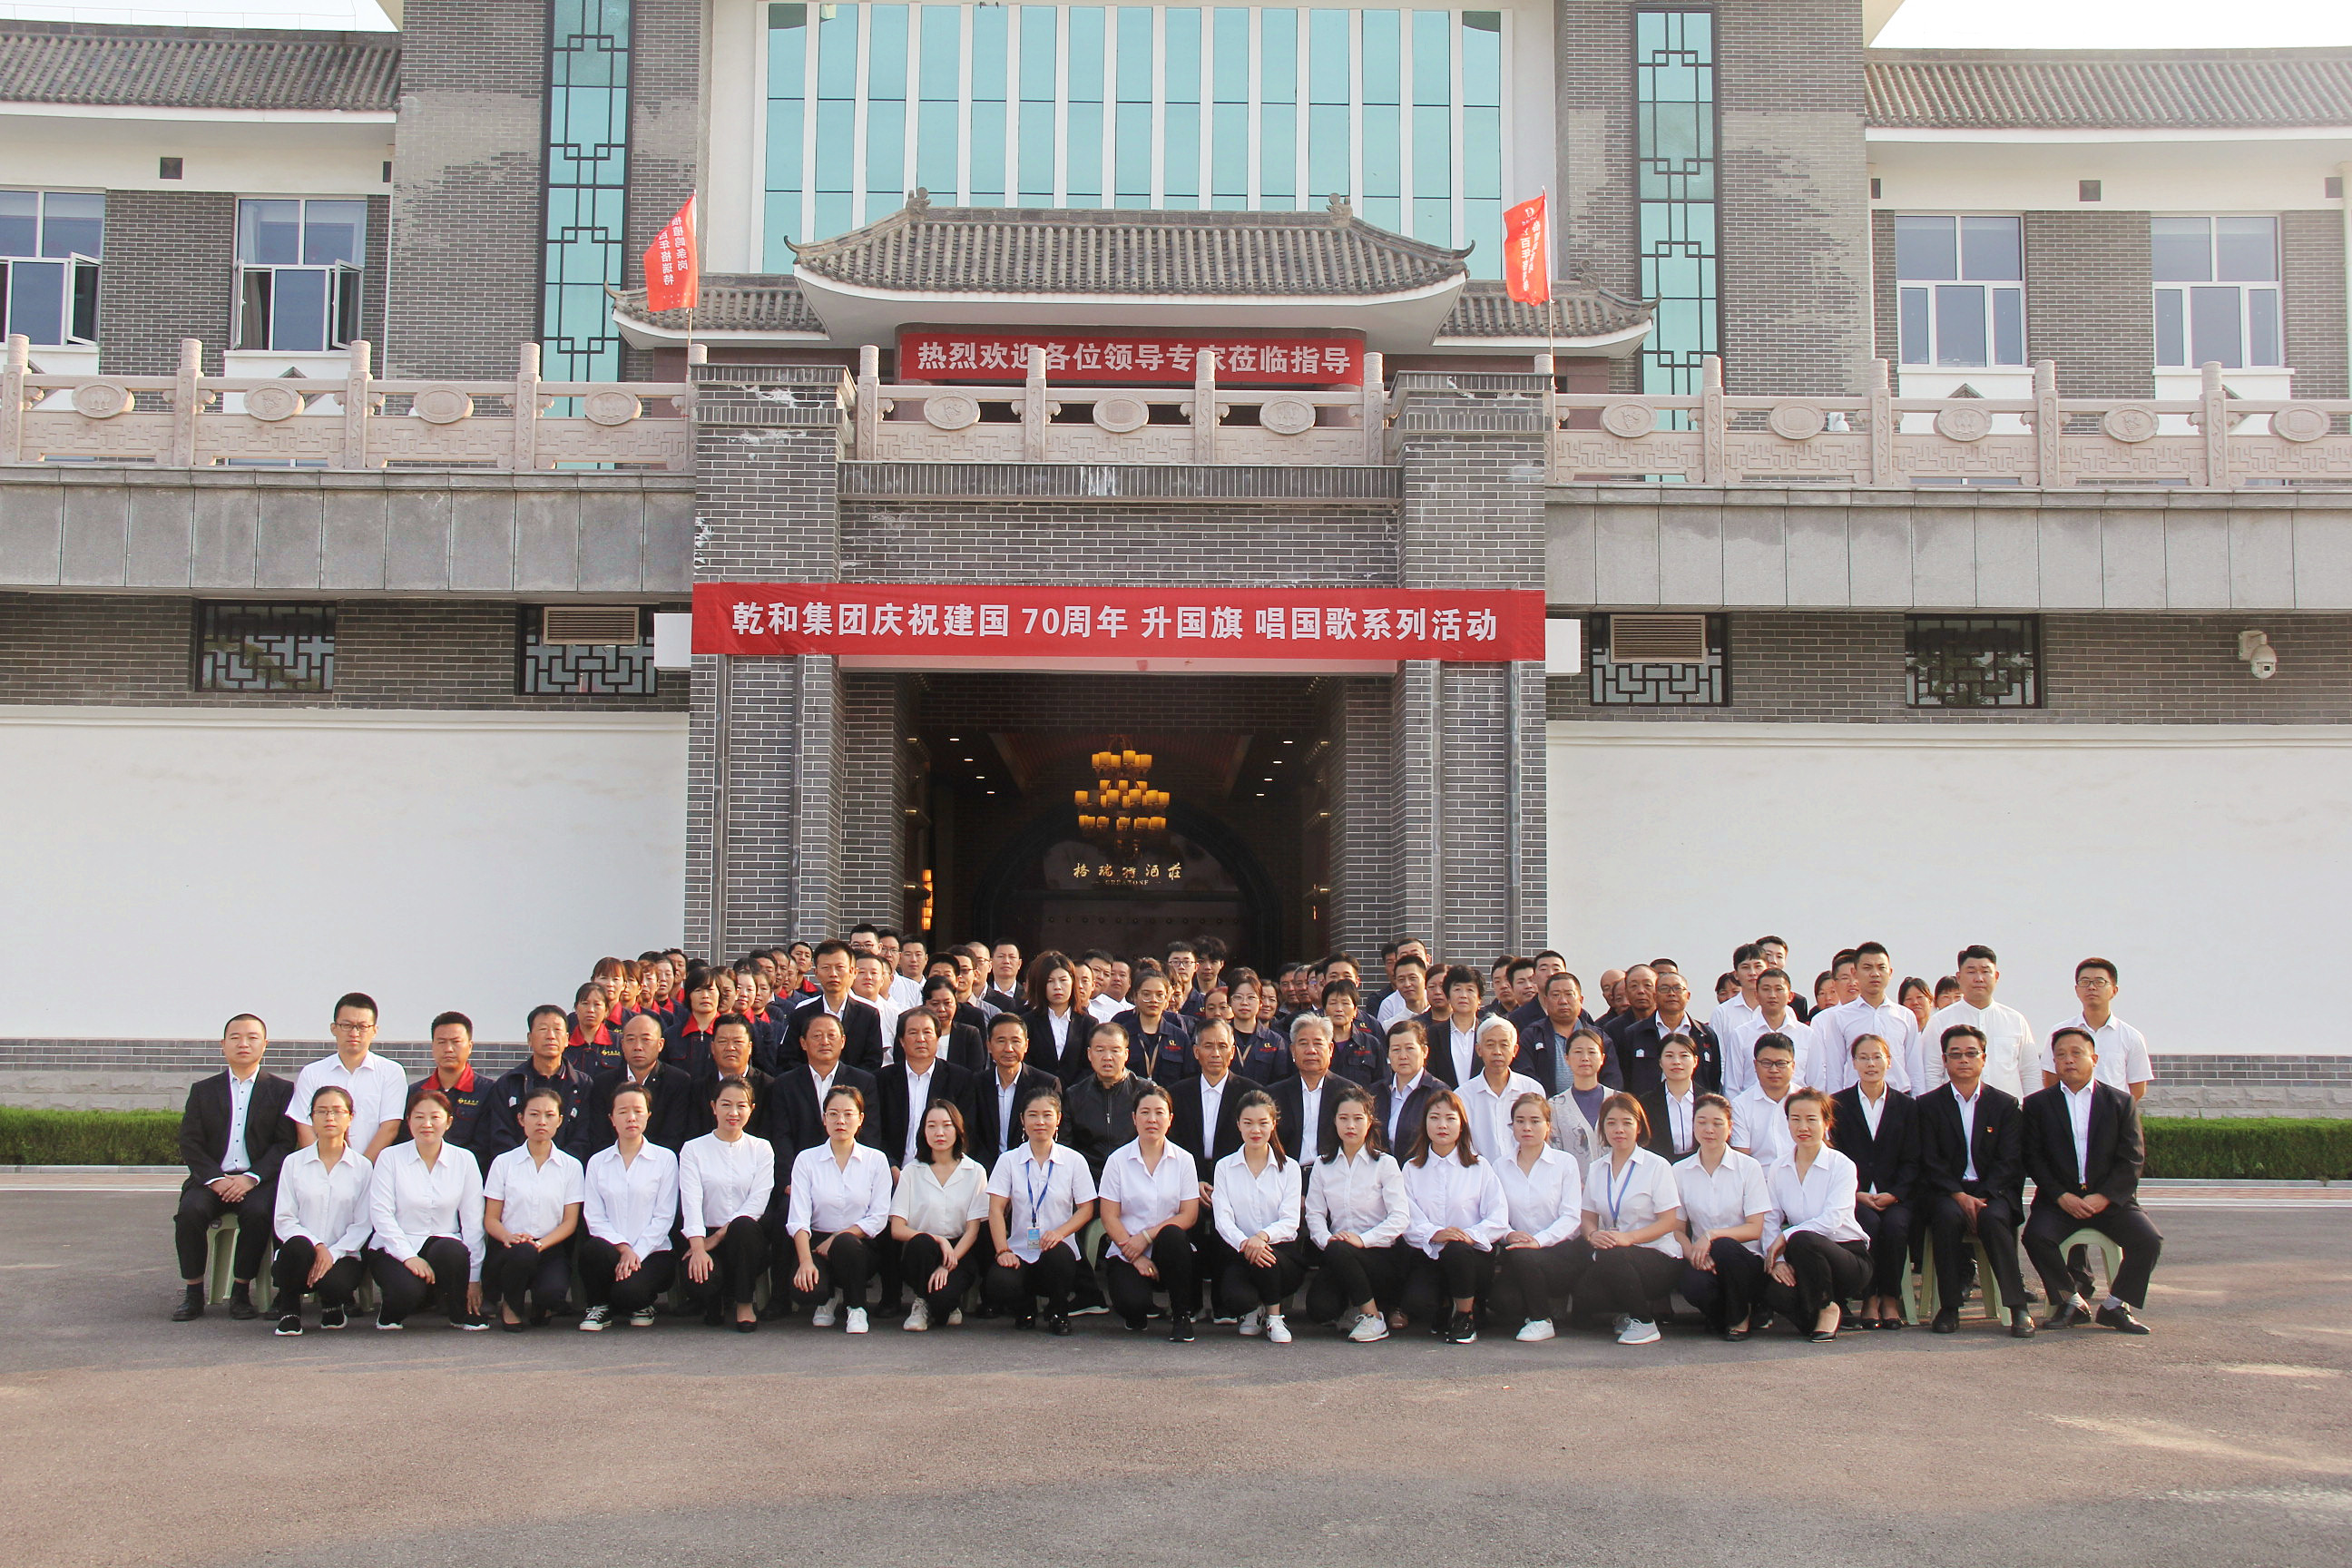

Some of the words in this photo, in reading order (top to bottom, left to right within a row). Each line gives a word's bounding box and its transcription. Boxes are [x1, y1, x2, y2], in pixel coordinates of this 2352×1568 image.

[731, 601, 1009, 637] 乾和集团庆祝建国
[1021, 604, 1128, 639] 70周年
[1141, 605, 1243, 640] 升国旗
[1255, 606, 1496, 642] 唱国歌系列活动
